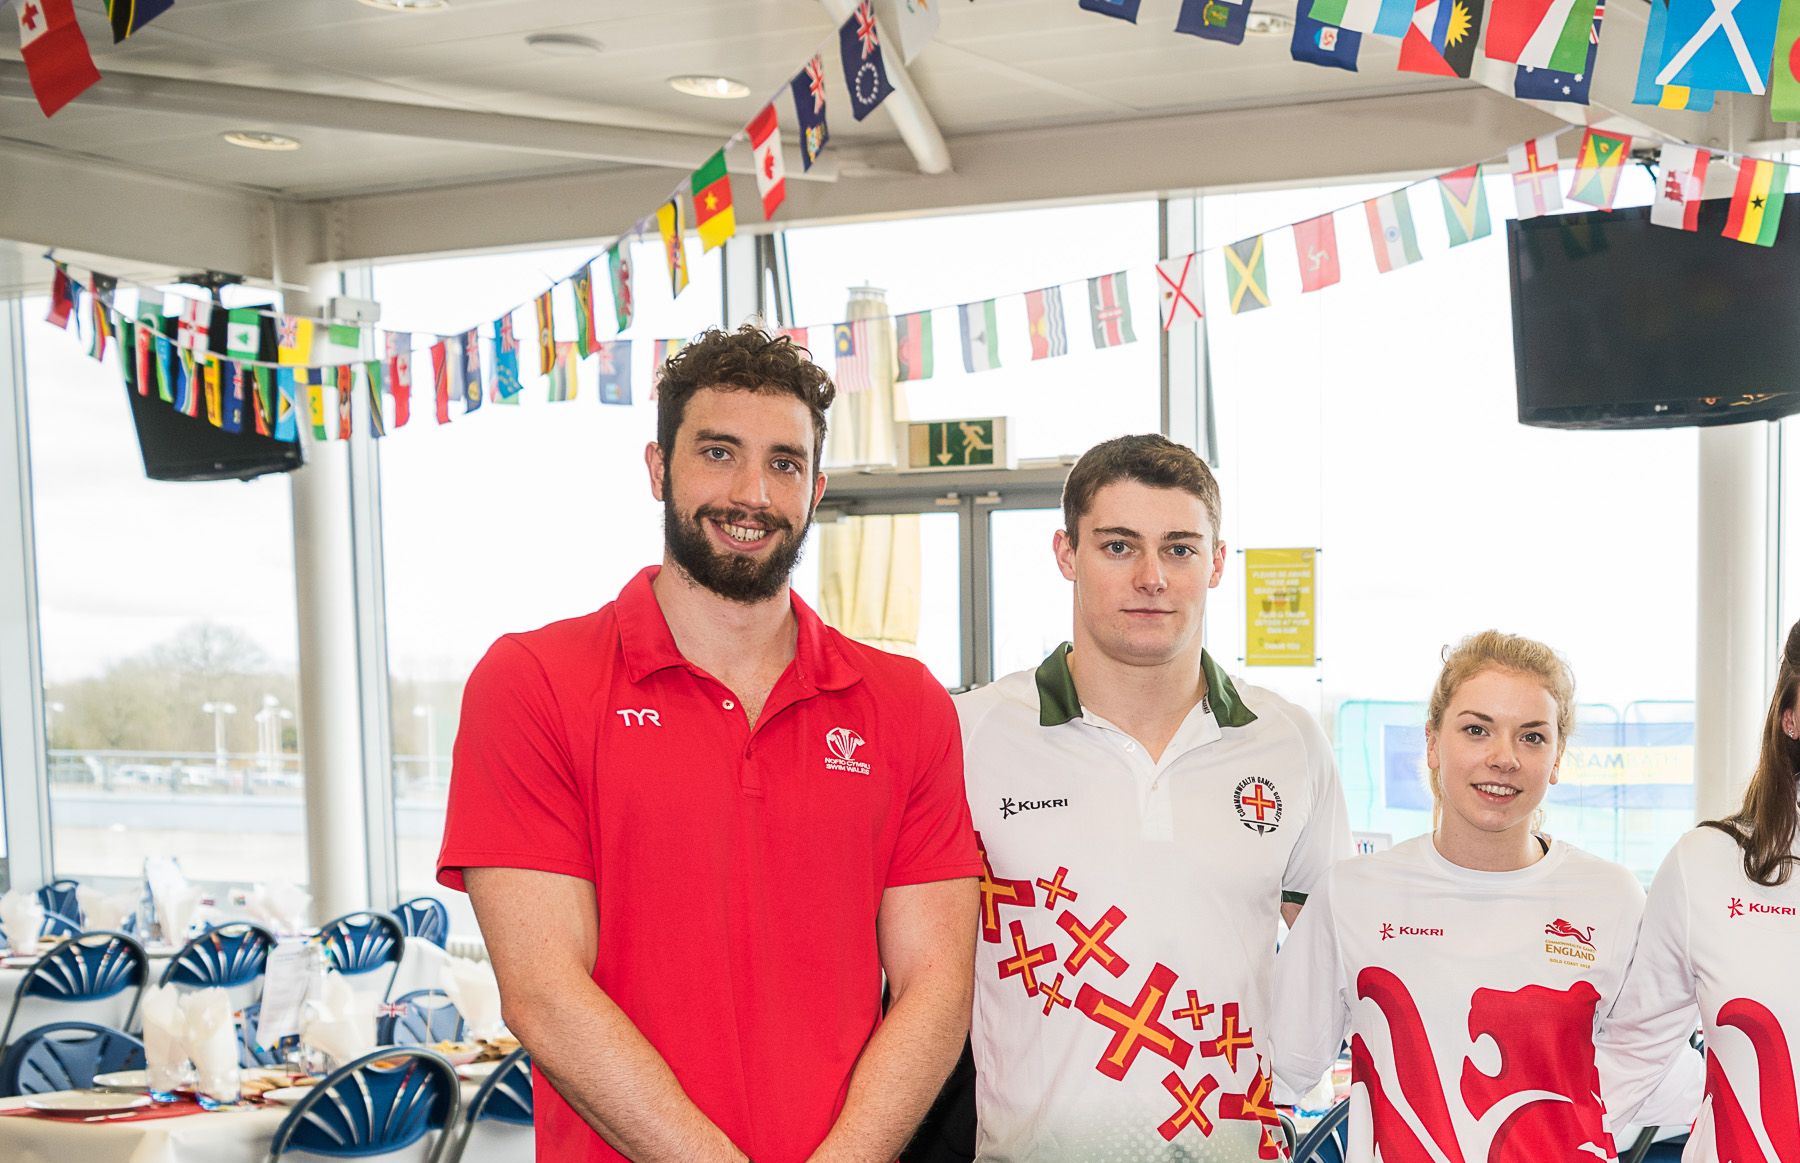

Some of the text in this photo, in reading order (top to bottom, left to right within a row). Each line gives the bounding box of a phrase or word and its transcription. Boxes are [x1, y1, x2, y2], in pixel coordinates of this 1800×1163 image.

[616, 708, 662, 727] TYR
[1018, 798, 1068, 811] KUKRI
[1749, 902, 1796, 916] KUKRI
[1399, 926, 1444, 937] KUKRI
[1545, 943, 1596, 962] ENGLAND
